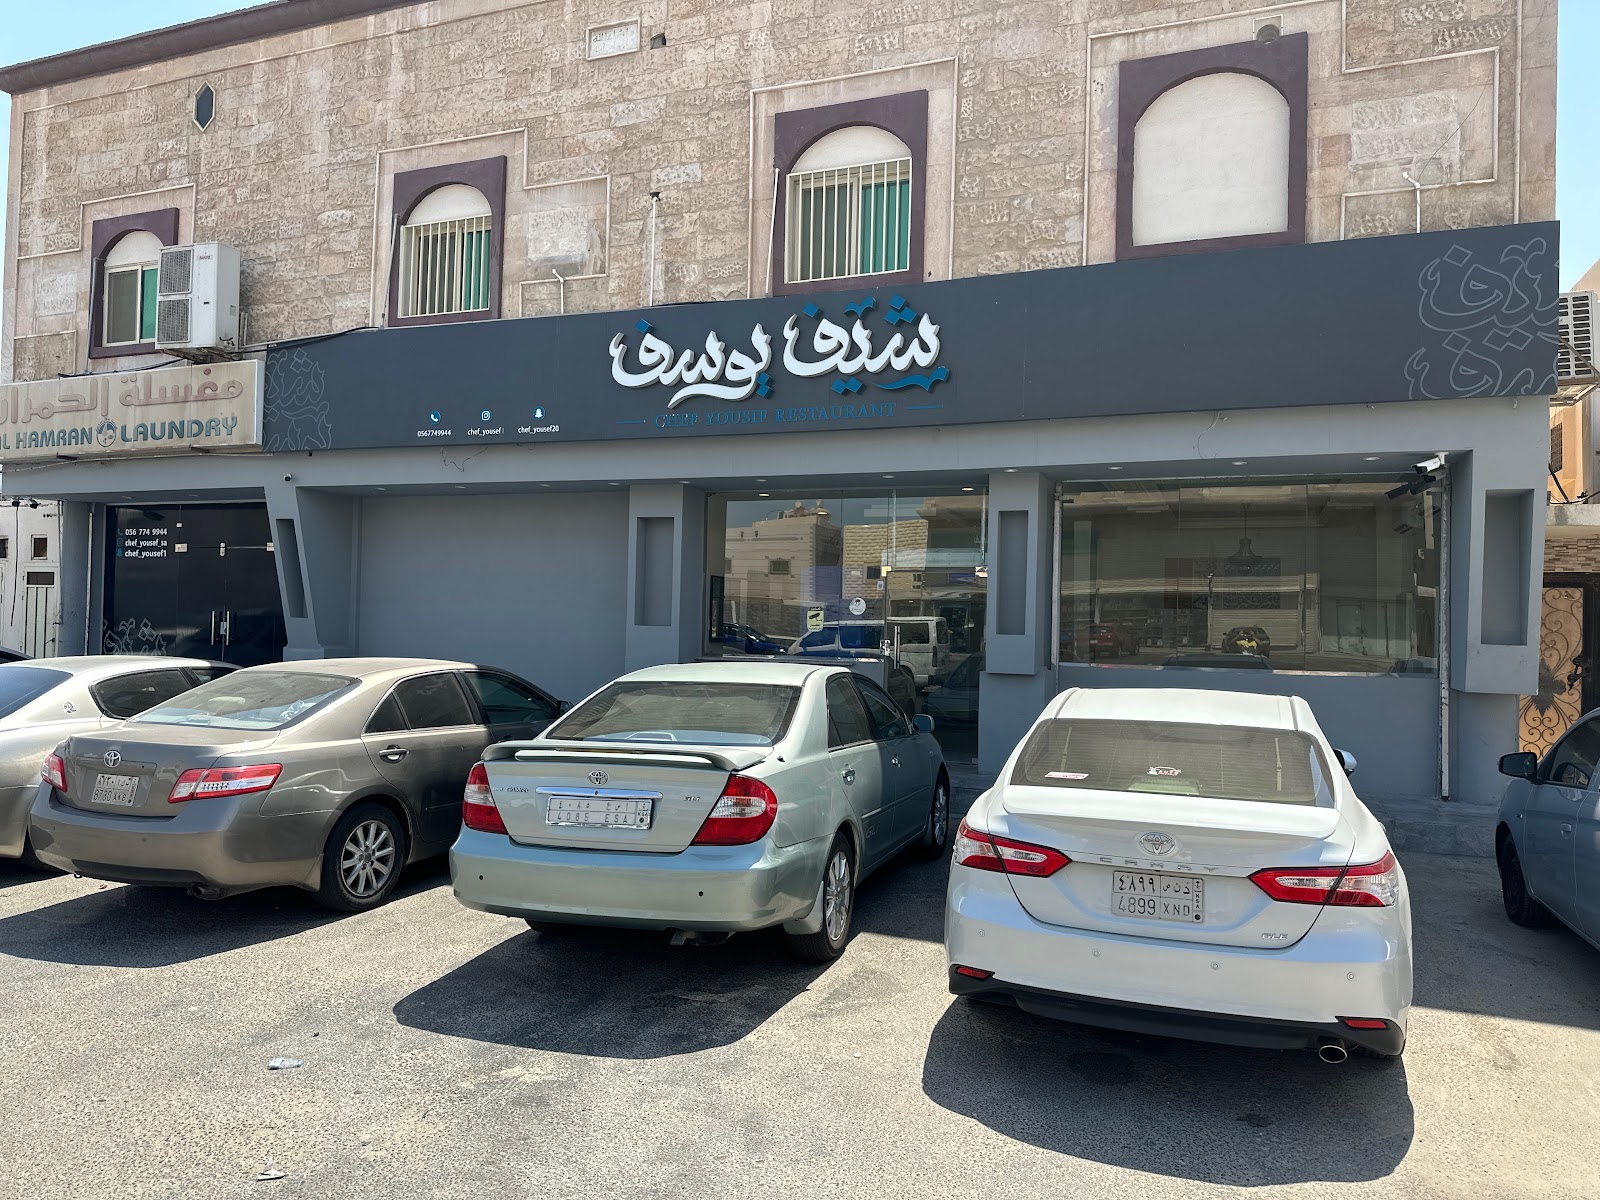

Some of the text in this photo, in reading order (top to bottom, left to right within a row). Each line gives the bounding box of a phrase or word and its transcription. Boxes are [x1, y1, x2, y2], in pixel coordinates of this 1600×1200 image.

[608, 295, 949, 409] شيف يوسف
[119, 368, 243, 407] مغسلة
[653, 402, 897, 428] CHEF YOUSIF RESTAURANT
[0, 433, 10, 450] L
[16, 427, 93, 449] HAMRAN
[120, 416, 238, 443] LAUNDRY
[125, 528, 167, 536] 056 774 9944
[125, 538, 167, 548] chef_yousef_sa
[124, 549, 167, 559] chef_yousef1
[604, 813, 628, 824] ESA
[1118, 896, 1190, 917] 4899 XND
[1261, 932, 1288, 940] GLE
